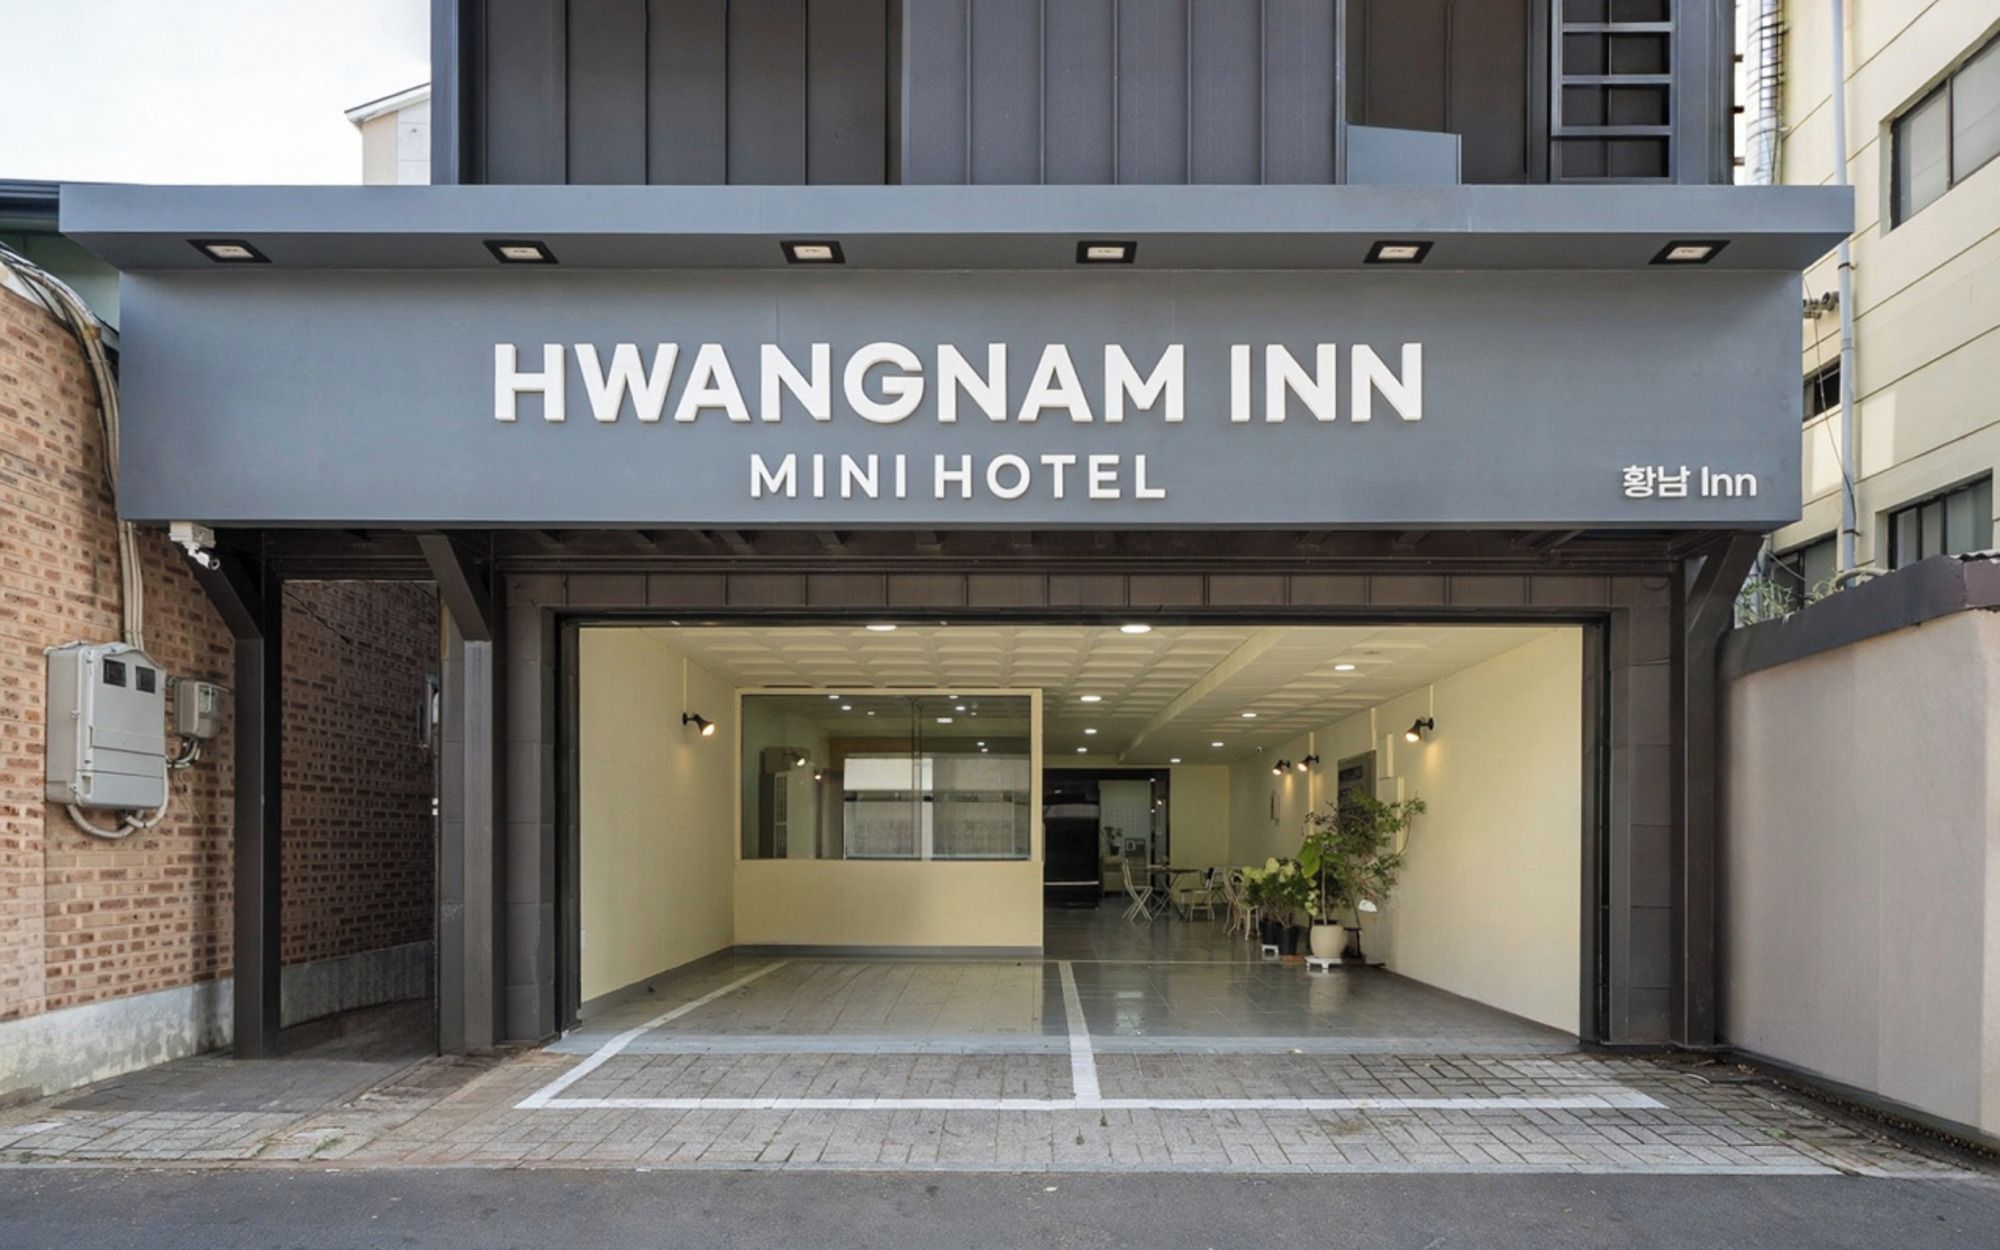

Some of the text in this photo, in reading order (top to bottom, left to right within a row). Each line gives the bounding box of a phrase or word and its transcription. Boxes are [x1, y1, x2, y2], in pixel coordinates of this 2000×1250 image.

[493, 341, 1423, 423] HWANGNAM INN
[749, 453, 1167, 499] MINI HOTEL
[1622, 464, 1758, 498] 황남 Inn
